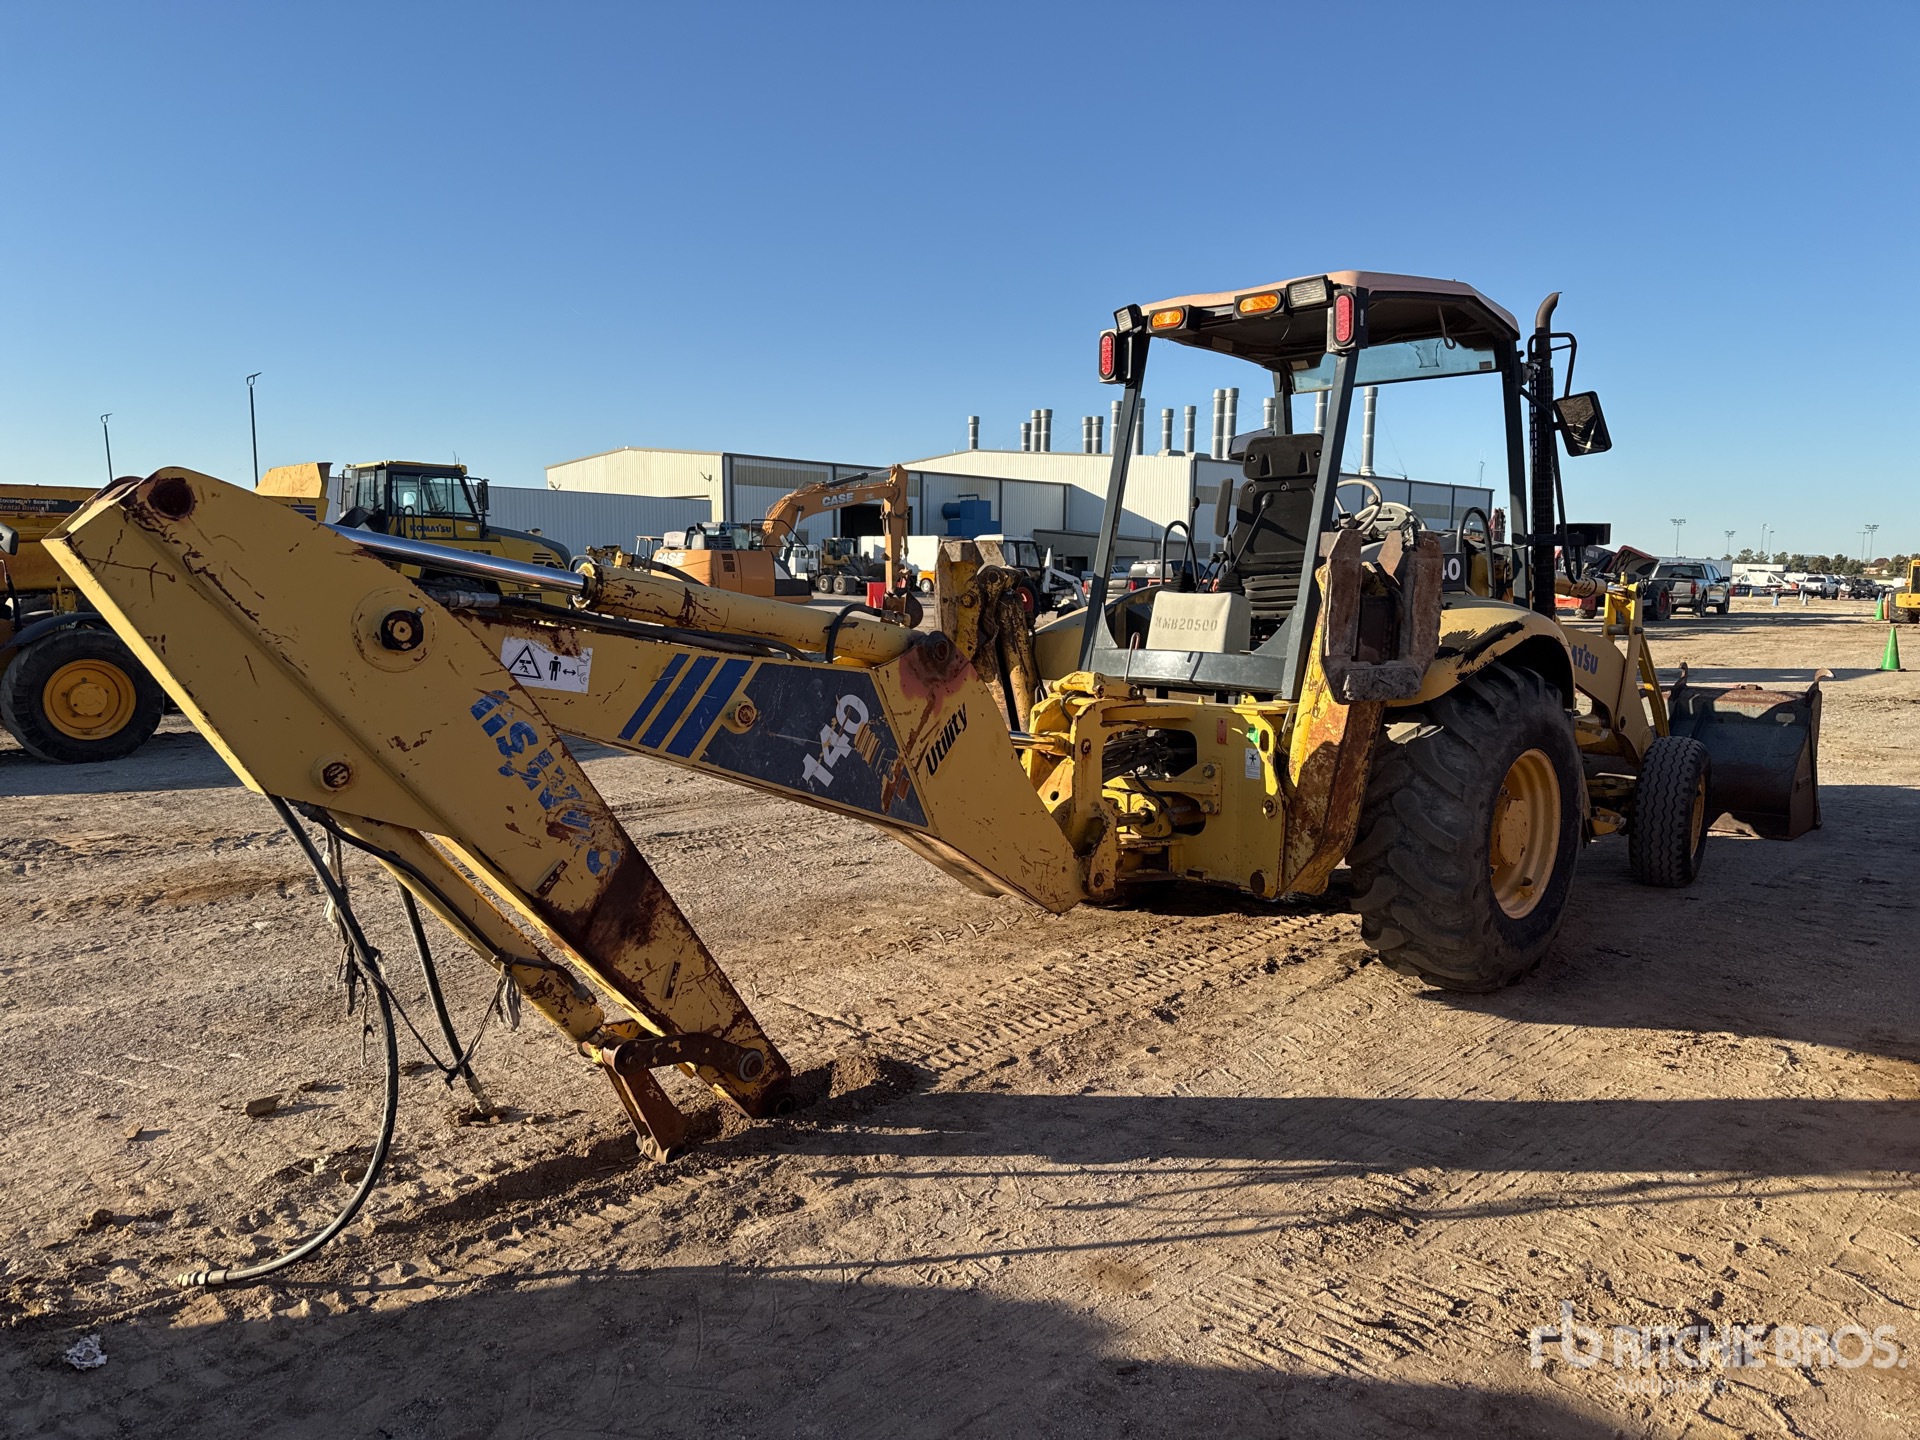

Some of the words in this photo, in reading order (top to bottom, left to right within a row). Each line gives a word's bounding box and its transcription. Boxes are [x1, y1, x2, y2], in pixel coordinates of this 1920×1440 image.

[821, 492, 854, 507] CASE
[410, 524, 452, 533] KOMATSU
[656, 552, 686, 566] CASE
[802, 694, 869, 787] 140
[925, 702, 968, 776] Utility
